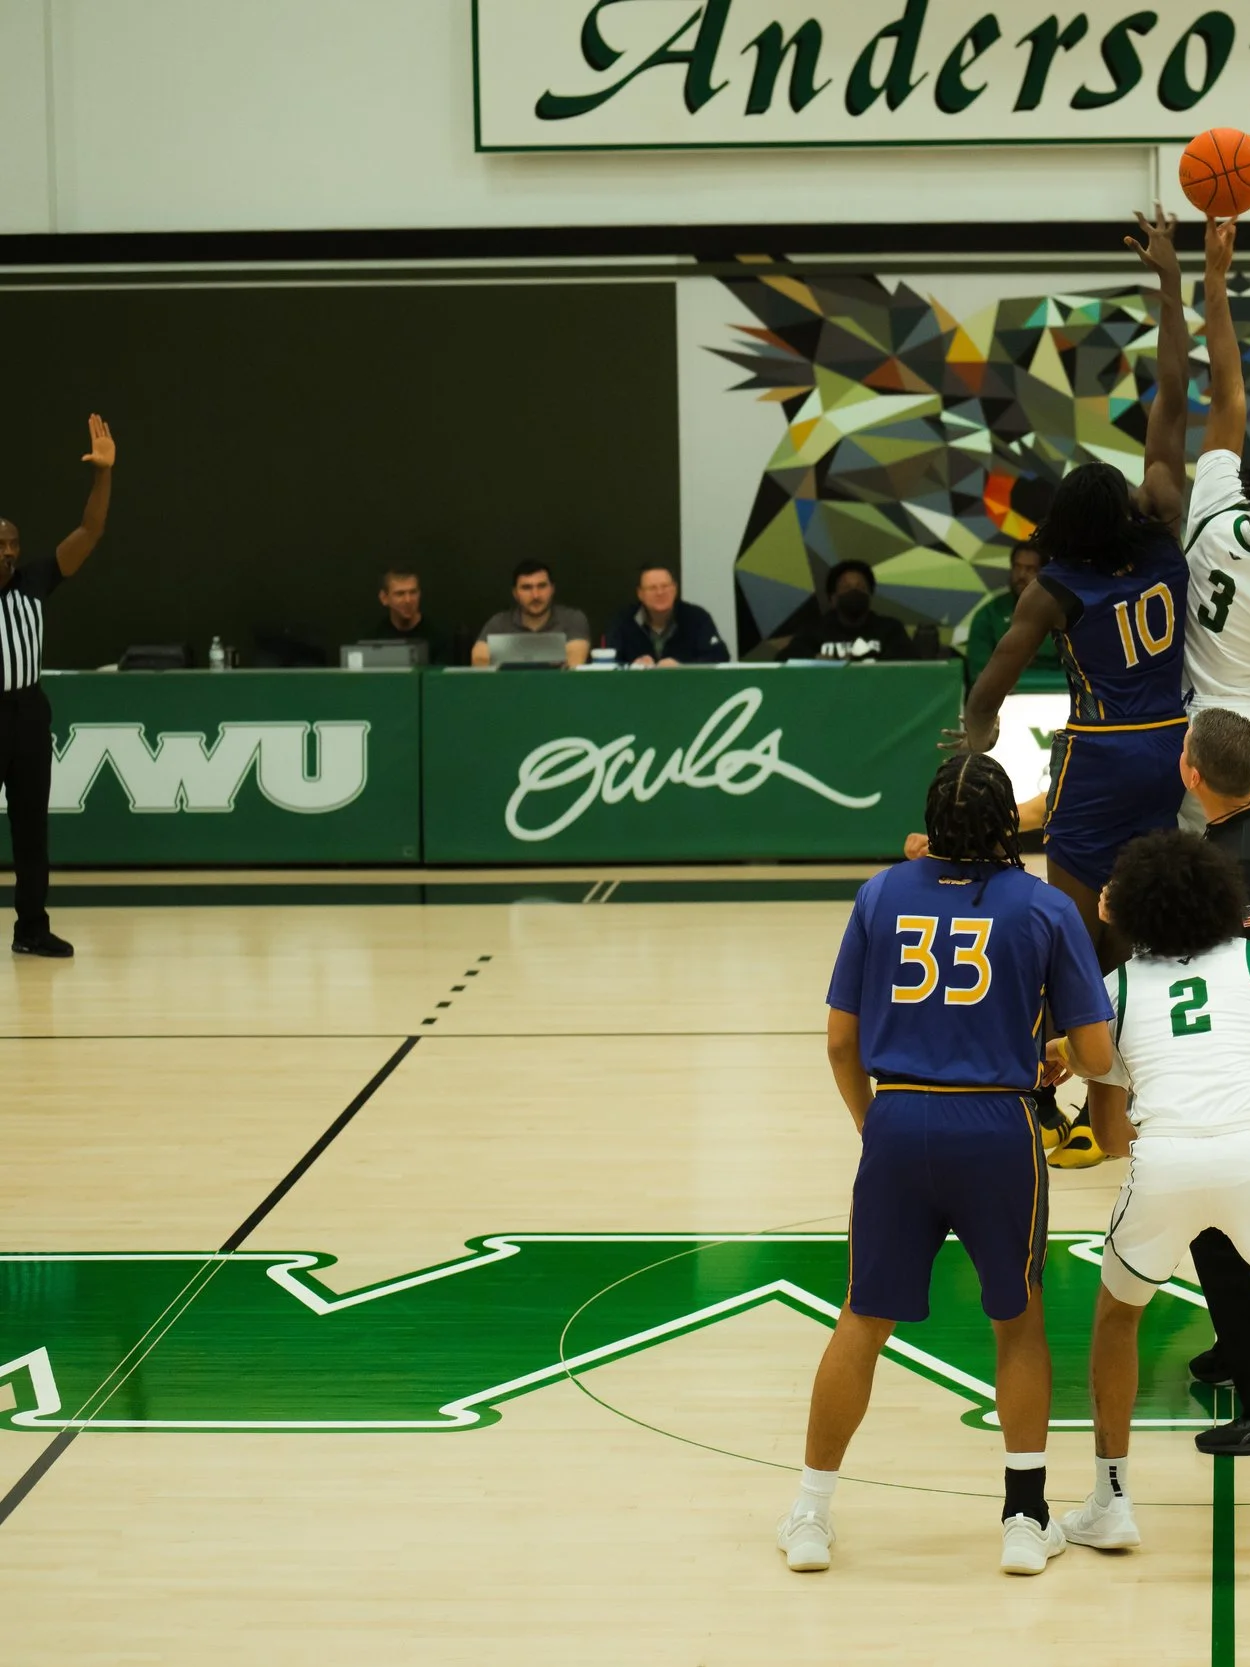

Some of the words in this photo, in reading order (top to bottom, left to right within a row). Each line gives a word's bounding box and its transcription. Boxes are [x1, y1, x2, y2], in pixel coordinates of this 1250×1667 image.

[1113, 581, 1175, 669] 10
[1197, 569, 1236, 634] 3
[891, 915, 994, 1006] 33
[1169, 976, 1212, 1037] 2
